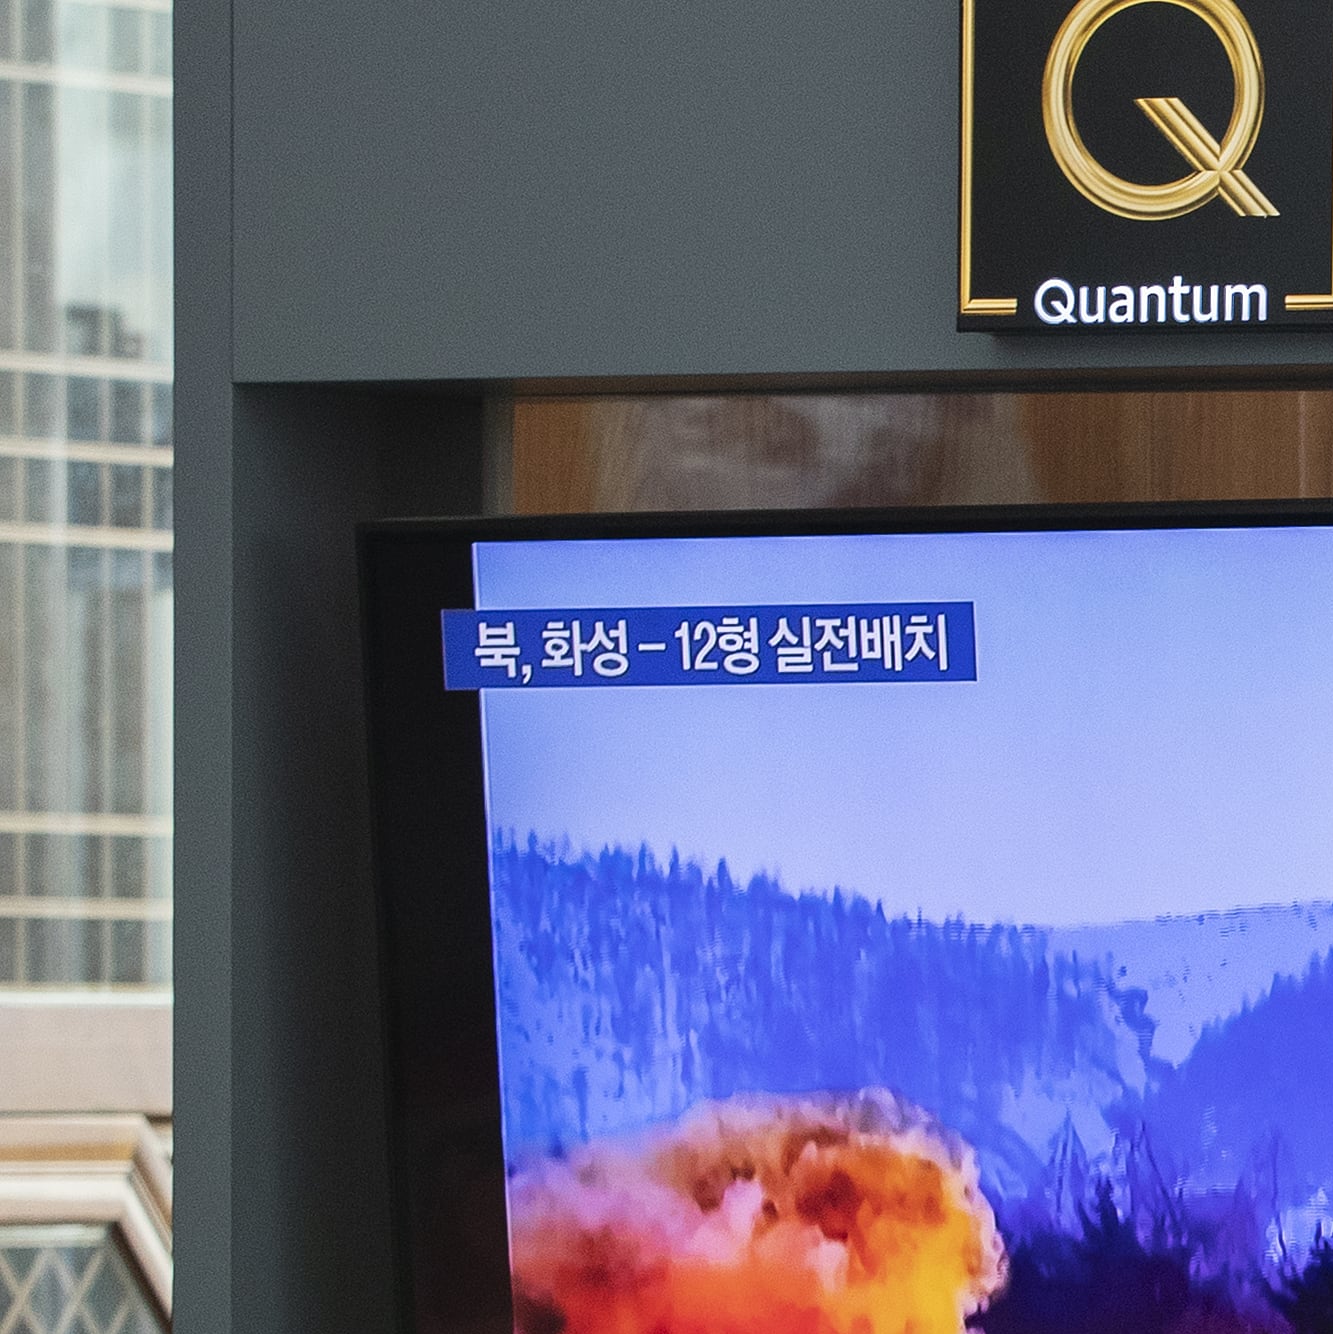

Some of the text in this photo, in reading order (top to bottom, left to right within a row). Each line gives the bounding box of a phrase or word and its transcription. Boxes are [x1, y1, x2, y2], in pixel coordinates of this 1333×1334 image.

[1040, 0, 1280, 221] Q
[1033, 276, 1269, 326] Quantum
[474, 622, 534, 684] 북,
[768, 613, 948, 673] 실전배치
